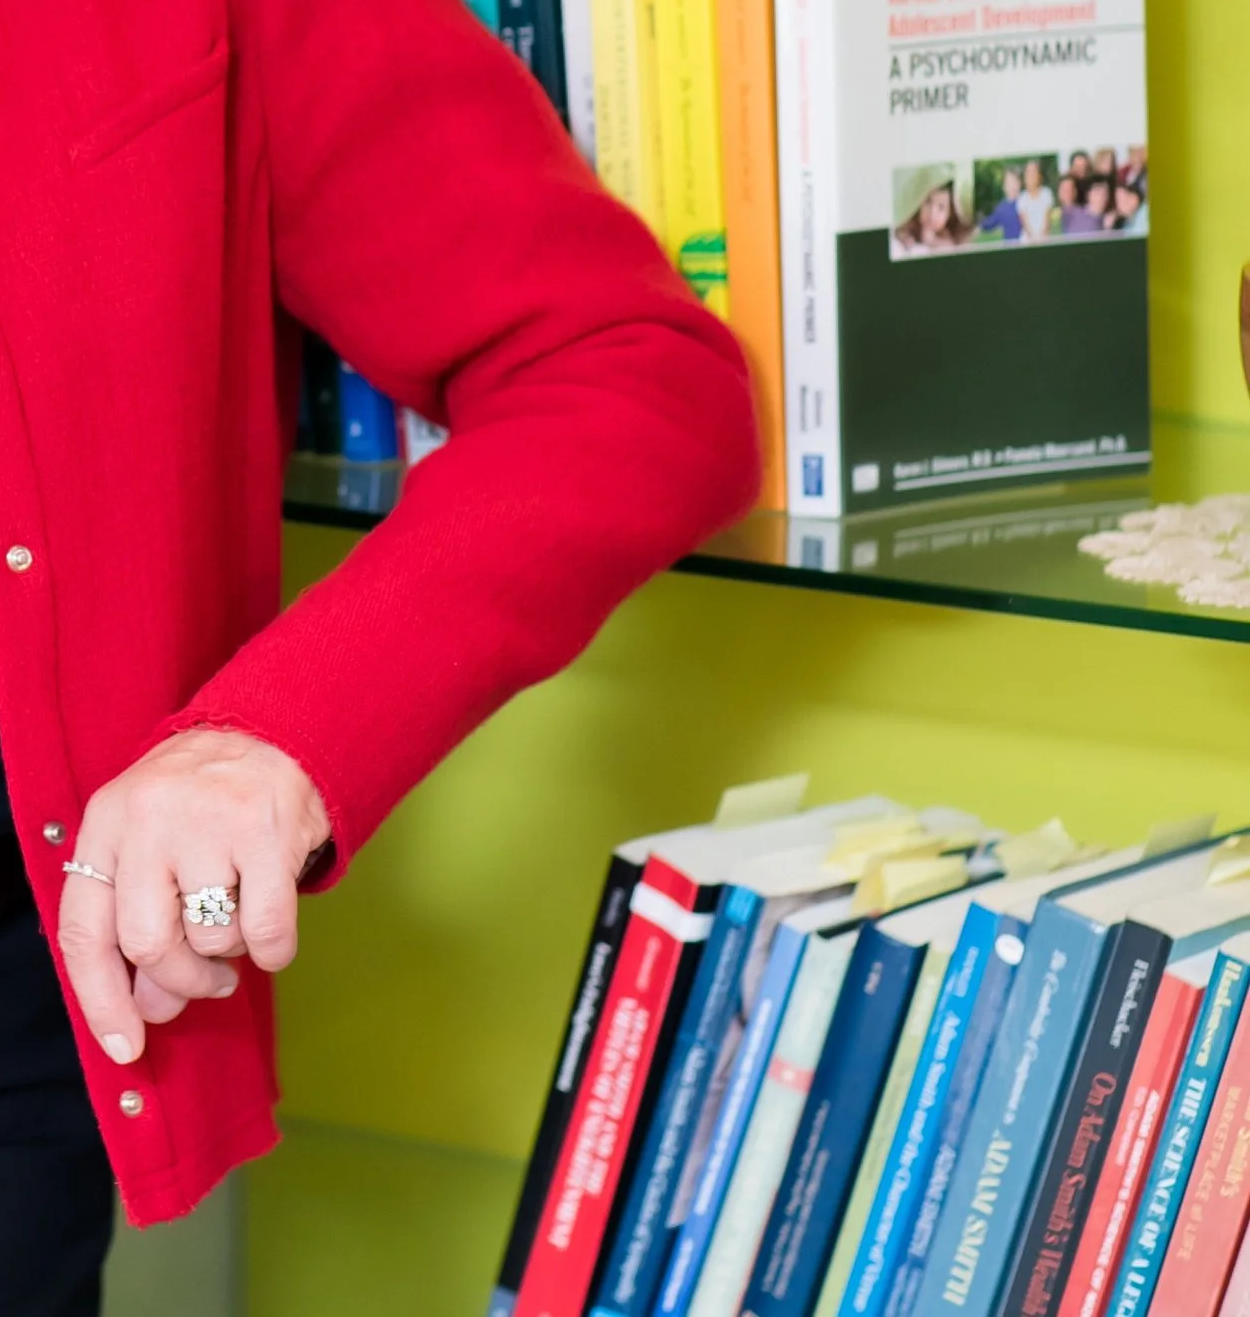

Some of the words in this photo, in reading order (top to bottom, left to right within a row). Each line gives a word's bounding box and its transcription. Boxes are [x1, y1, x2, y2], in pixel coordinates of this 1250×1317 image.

[888, 9, 977, 38] Adolescent
[889, 55, 901, 81] A
[909, 38, 1098, 78] PSYCHODYNAMIC
[889, 81, 969, 116] PRIMER
[1086, 1069, 1118, 1109] On
[1178, 1075, 1206, 1124] THE
[1067, 1107, 1106, 1170] Adam
[1196, 1086, 1242, 1202] MARKETPLACE
[971, 1128, 1014, 1215] ADAM
[1148, 1123, 1191, 1219] SCIENCE
[1043, 1167, 1087, 1248] Smith's
[942, 1214, 988, 1306] SMITH
[1136, 1219, 1161, 1254] OF
